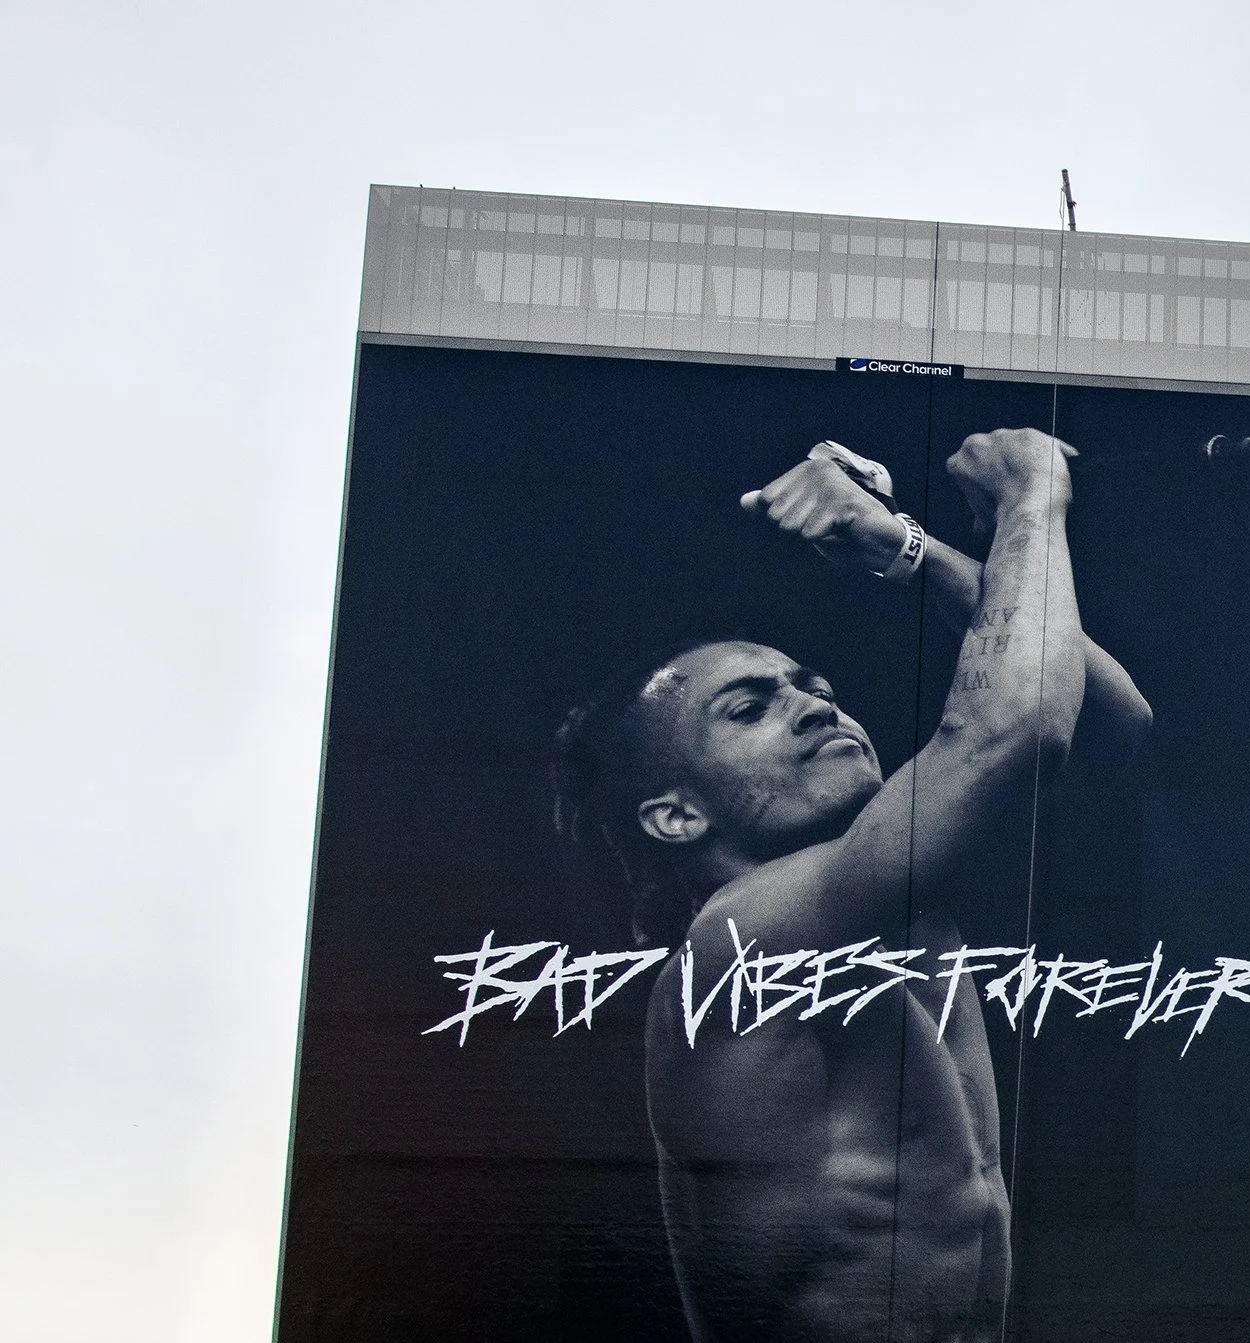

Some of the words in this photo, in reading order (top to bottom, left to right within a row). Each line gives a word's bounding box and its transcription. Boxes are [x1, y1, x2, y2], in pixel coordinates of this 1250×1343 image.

[868, 361, 901, 373] Clear
[902, 363, 952, 376] Channel
[421, 929, 669, 1048] BAD
[682, 917, 932, 1049] VIBES
